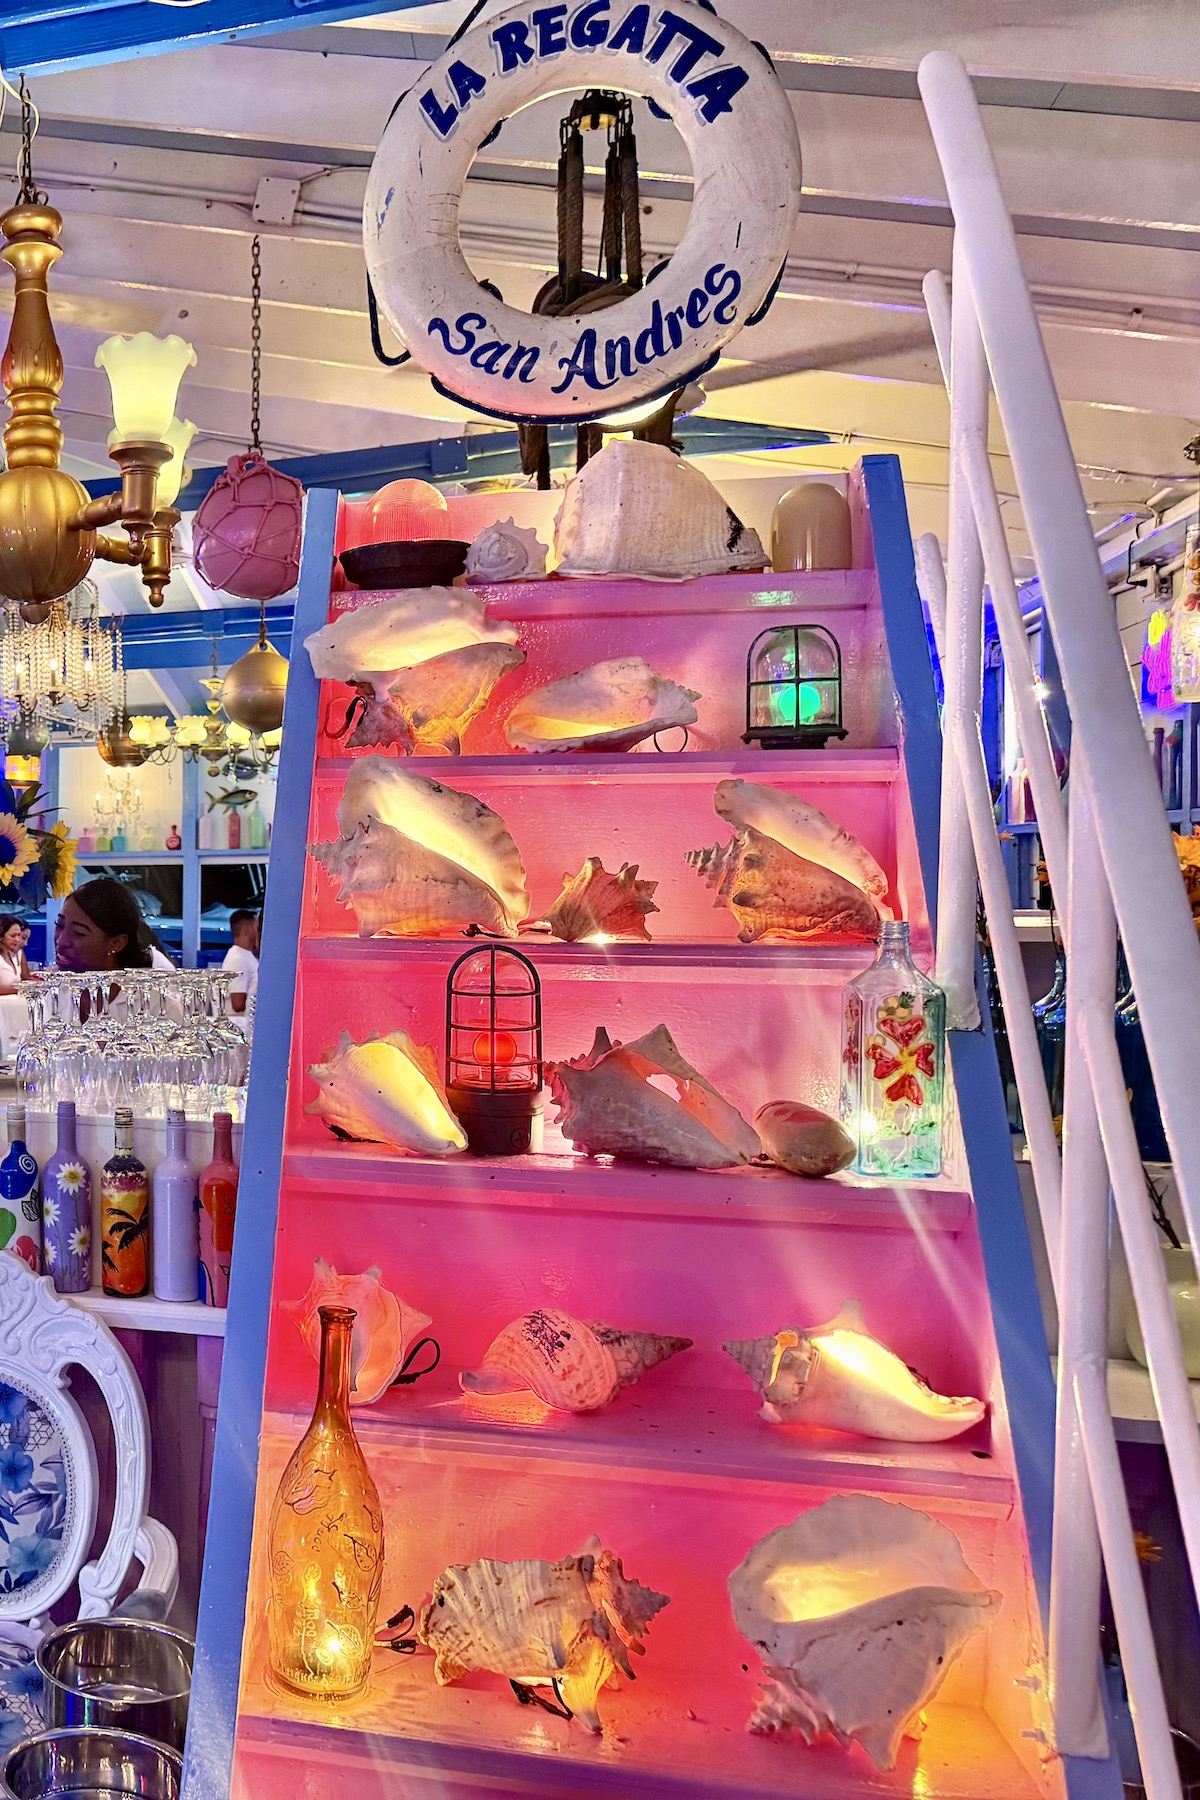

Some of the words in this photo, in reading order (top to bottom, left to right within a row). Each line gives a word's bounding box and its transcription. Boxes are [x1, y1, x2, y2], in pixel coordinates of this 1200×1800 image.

[418, 60, 487, 138] LA
[492, 0, 750, 125] REGATTA
[427, 312, 544, 384] San
[550, 262, 741, 394] Andres
